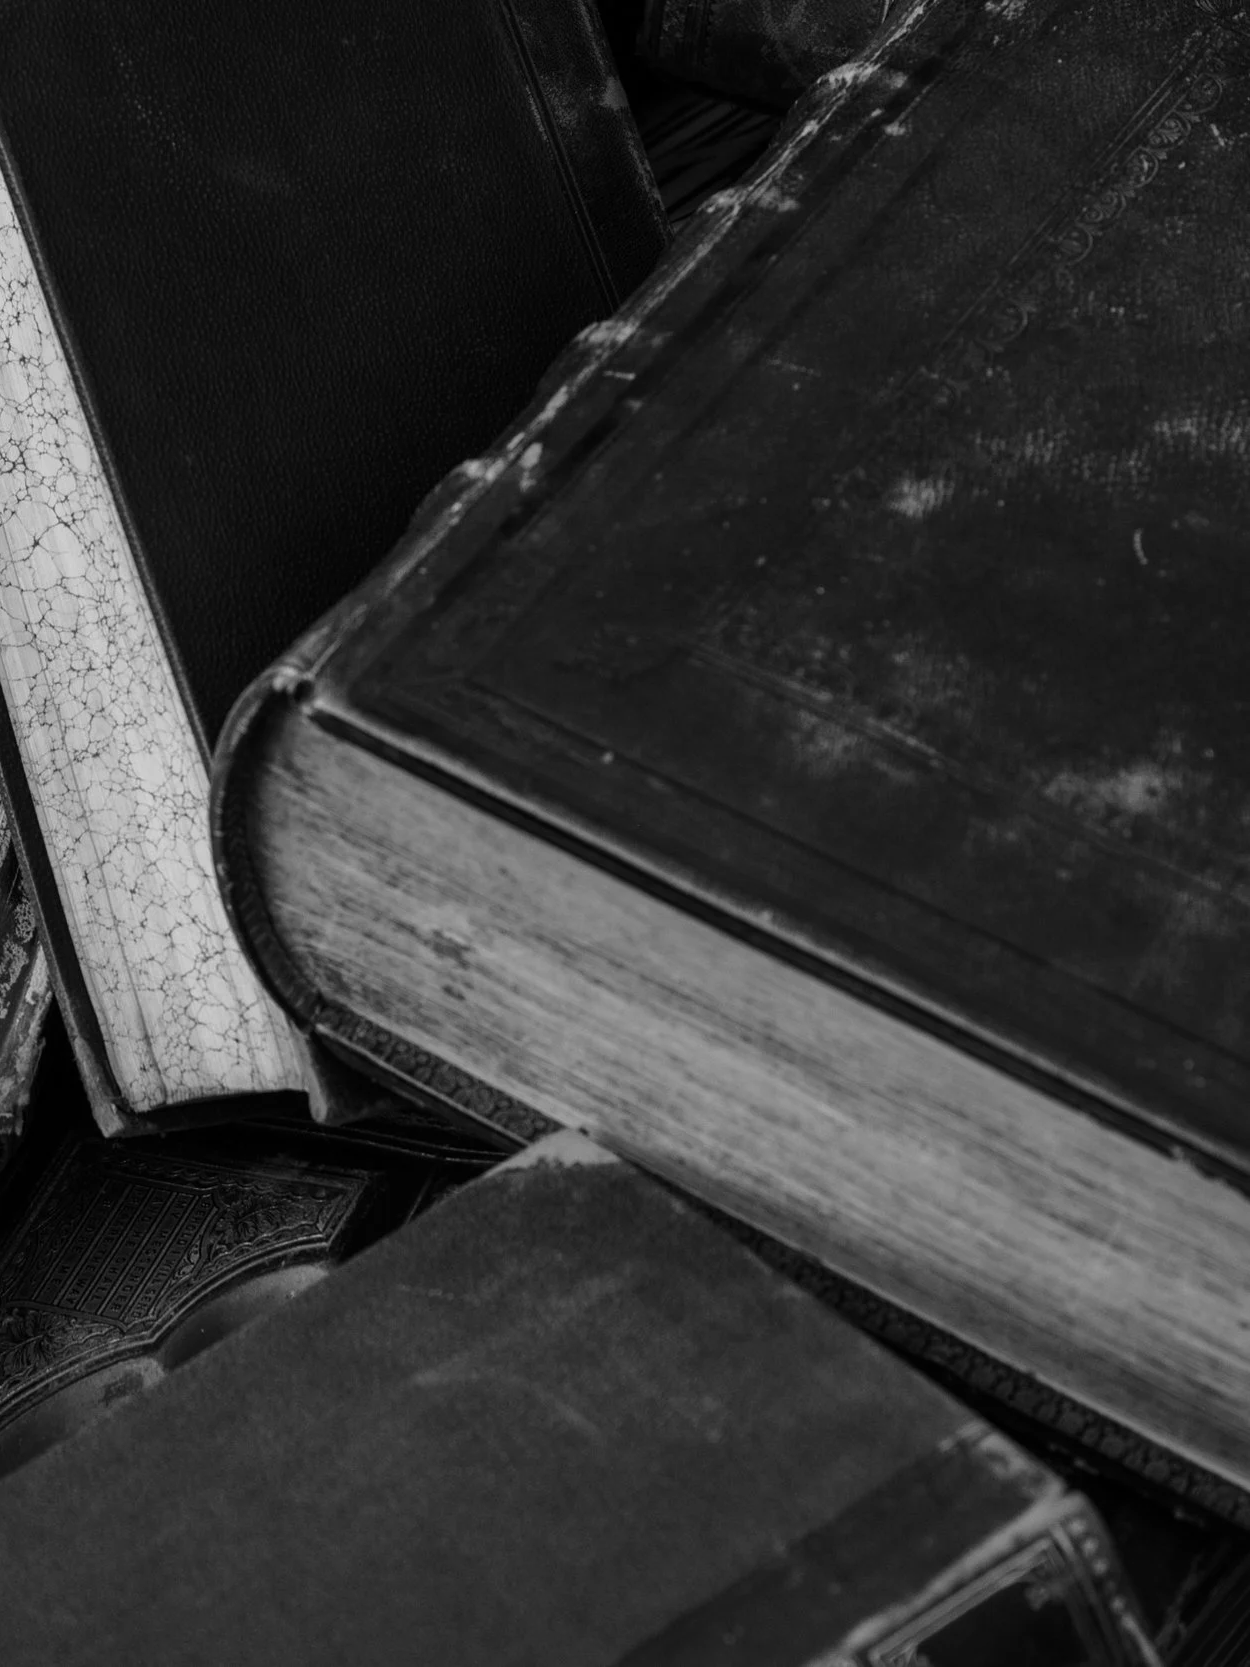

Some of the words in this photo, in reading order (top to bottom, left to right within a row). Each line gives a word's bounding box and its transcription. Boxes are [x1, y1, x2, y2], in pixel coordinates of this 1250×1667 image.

[167, 1200, 188, 1218] MY
[175, 1201, 212, 1246] BEHOLD
[124, 1229, 144, 1247] HE
[84, 1247, 108, 1272] THE
[107, 1229, 170, 1313] MESSENGER
[150, 1257, 177, 1285] WILL
[63, 1276, 89, 1304] WAY
[89, 1256, 128, 1301] SHALL
[129, 1287, 158, 1319] SEND
